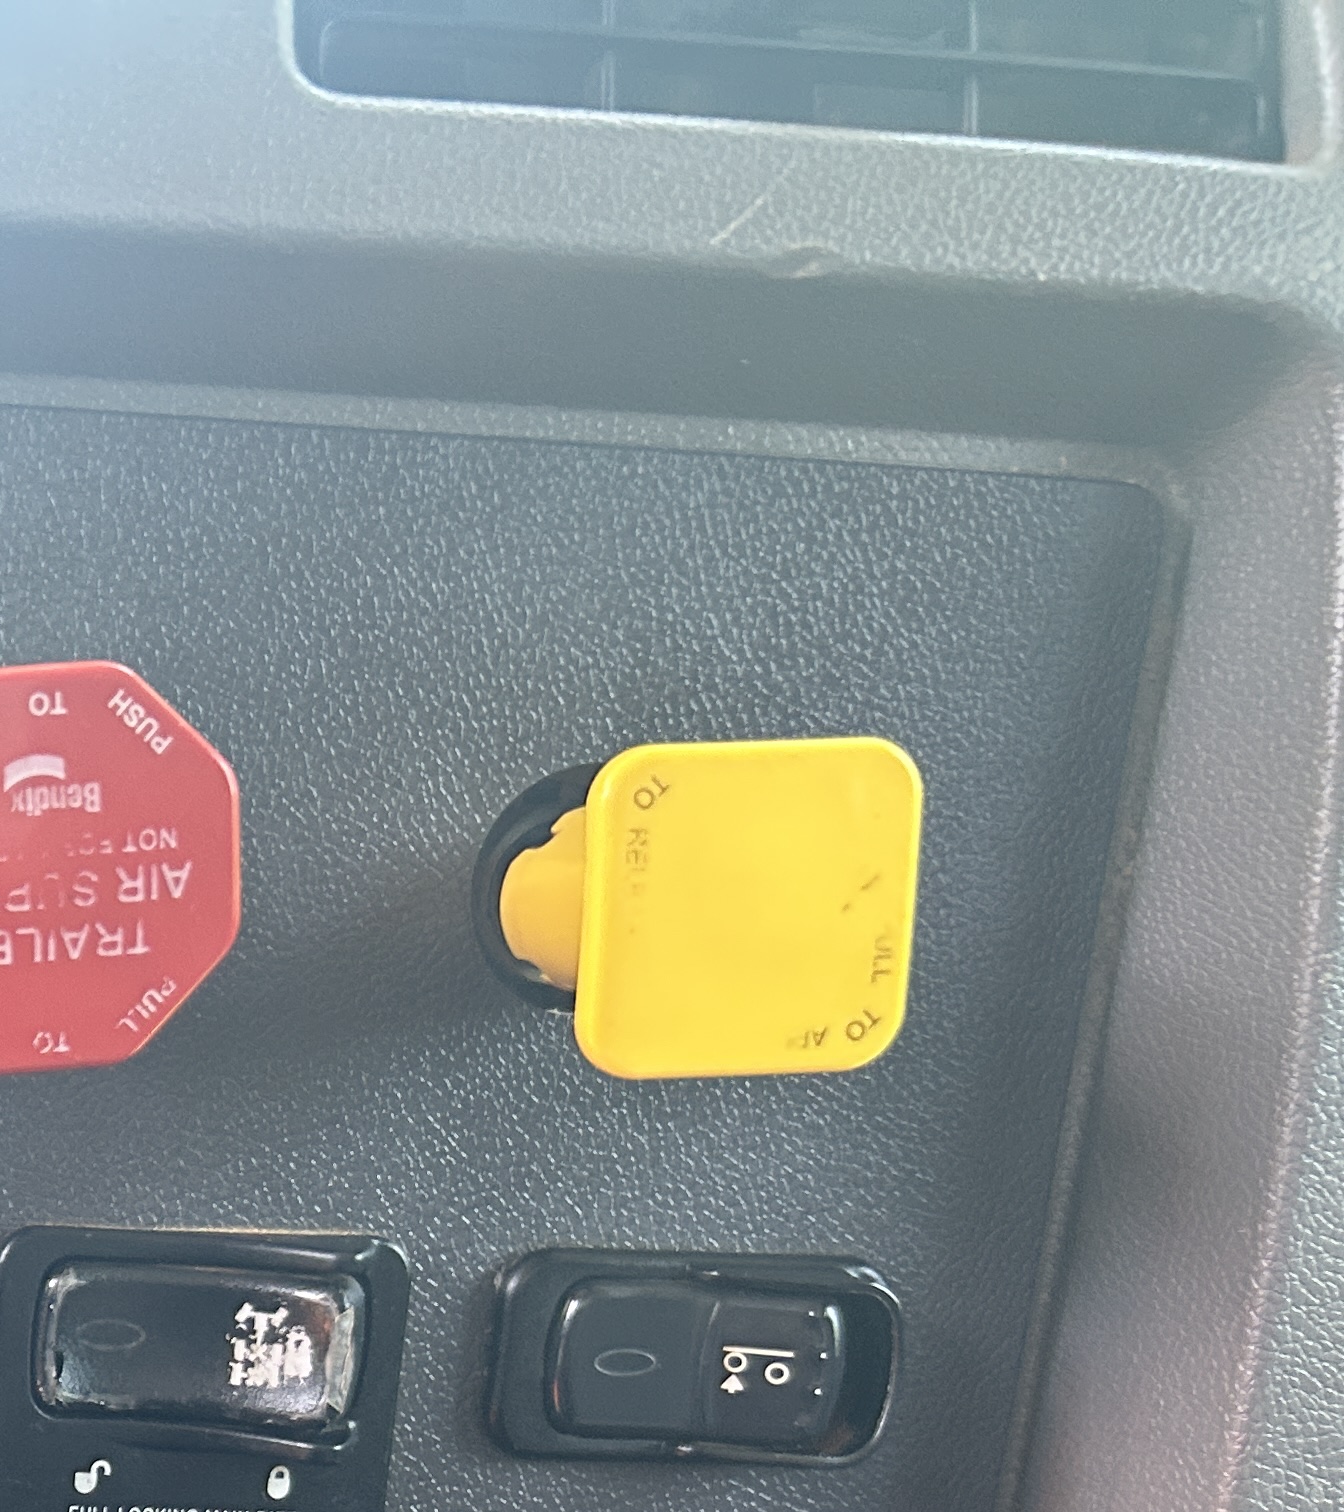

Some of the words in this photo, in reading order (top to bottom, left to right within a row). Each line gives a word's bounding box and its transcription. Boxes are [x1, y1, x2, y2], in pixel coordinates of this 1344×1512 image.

[28, 691, 68, 716] TO
[106, 688, 174, 756] PUSH
[10, 782, 102, 817] Bendix
[633, 775, 671, 810] TO
[121, 827, 178, 853] NOT
[115, 860, 193, 903] AIR
[117, 975, 178, 1034] PULL
[32, 1031, 70, 1054] TO
[845, 1009, 882, 1042] TO
